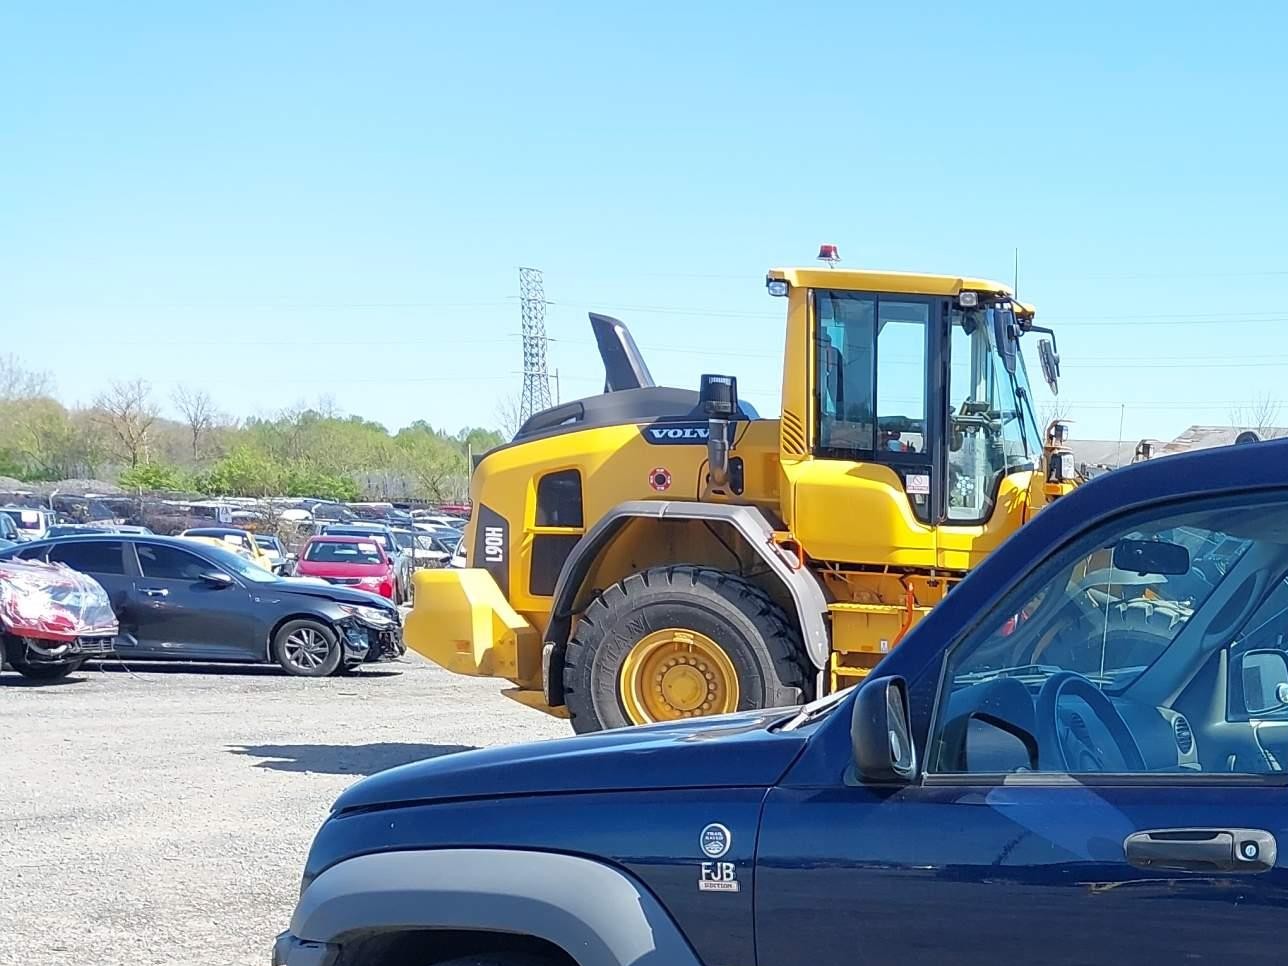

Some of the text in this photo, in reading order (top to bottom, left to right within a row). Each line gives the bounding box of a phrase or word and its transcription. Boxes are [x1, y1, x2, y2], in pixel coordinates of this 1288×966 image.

[650, 428, 709, 438] VOLV
[485, 526, 503, 562] L90H
[701, 862, 735, 881] FJB
